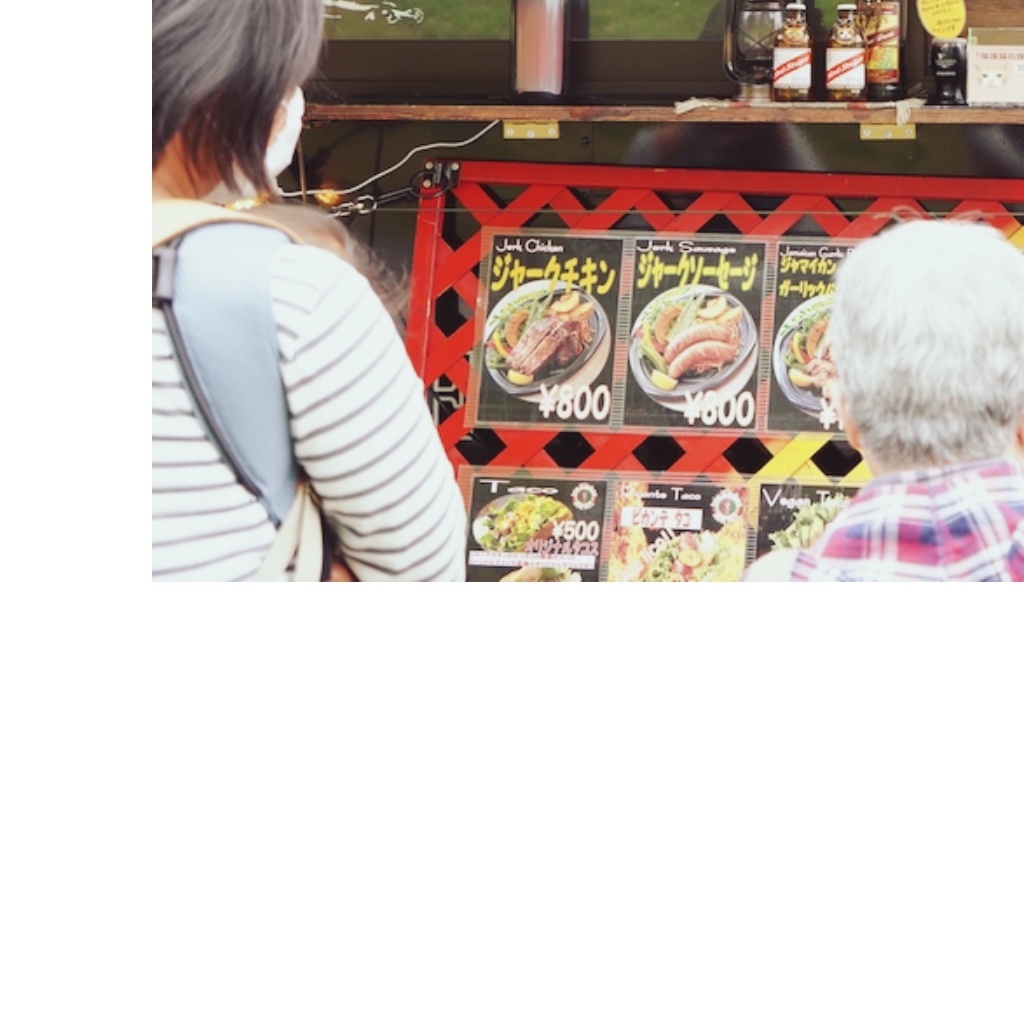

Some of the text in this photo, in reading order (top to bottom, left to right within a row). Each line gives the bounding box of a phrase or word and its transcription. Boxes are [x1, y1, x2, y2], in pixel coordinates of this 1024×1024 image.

[495, 238, 564, 253] Jerk Chicken
[637, 240, 674, 253] Jerk
[491, 252, 616, 295] ジャークチキン
[636, 251, 759, 291] ジャークソーセージ
[780, 256, 837, 275] ジャマイカン
[478, 478, 559, 495] Taco
[670, 487, 702, 501] Taco
[762, 488, 811, 510] Vegan
[552, 519, 600, 541] ¥500
